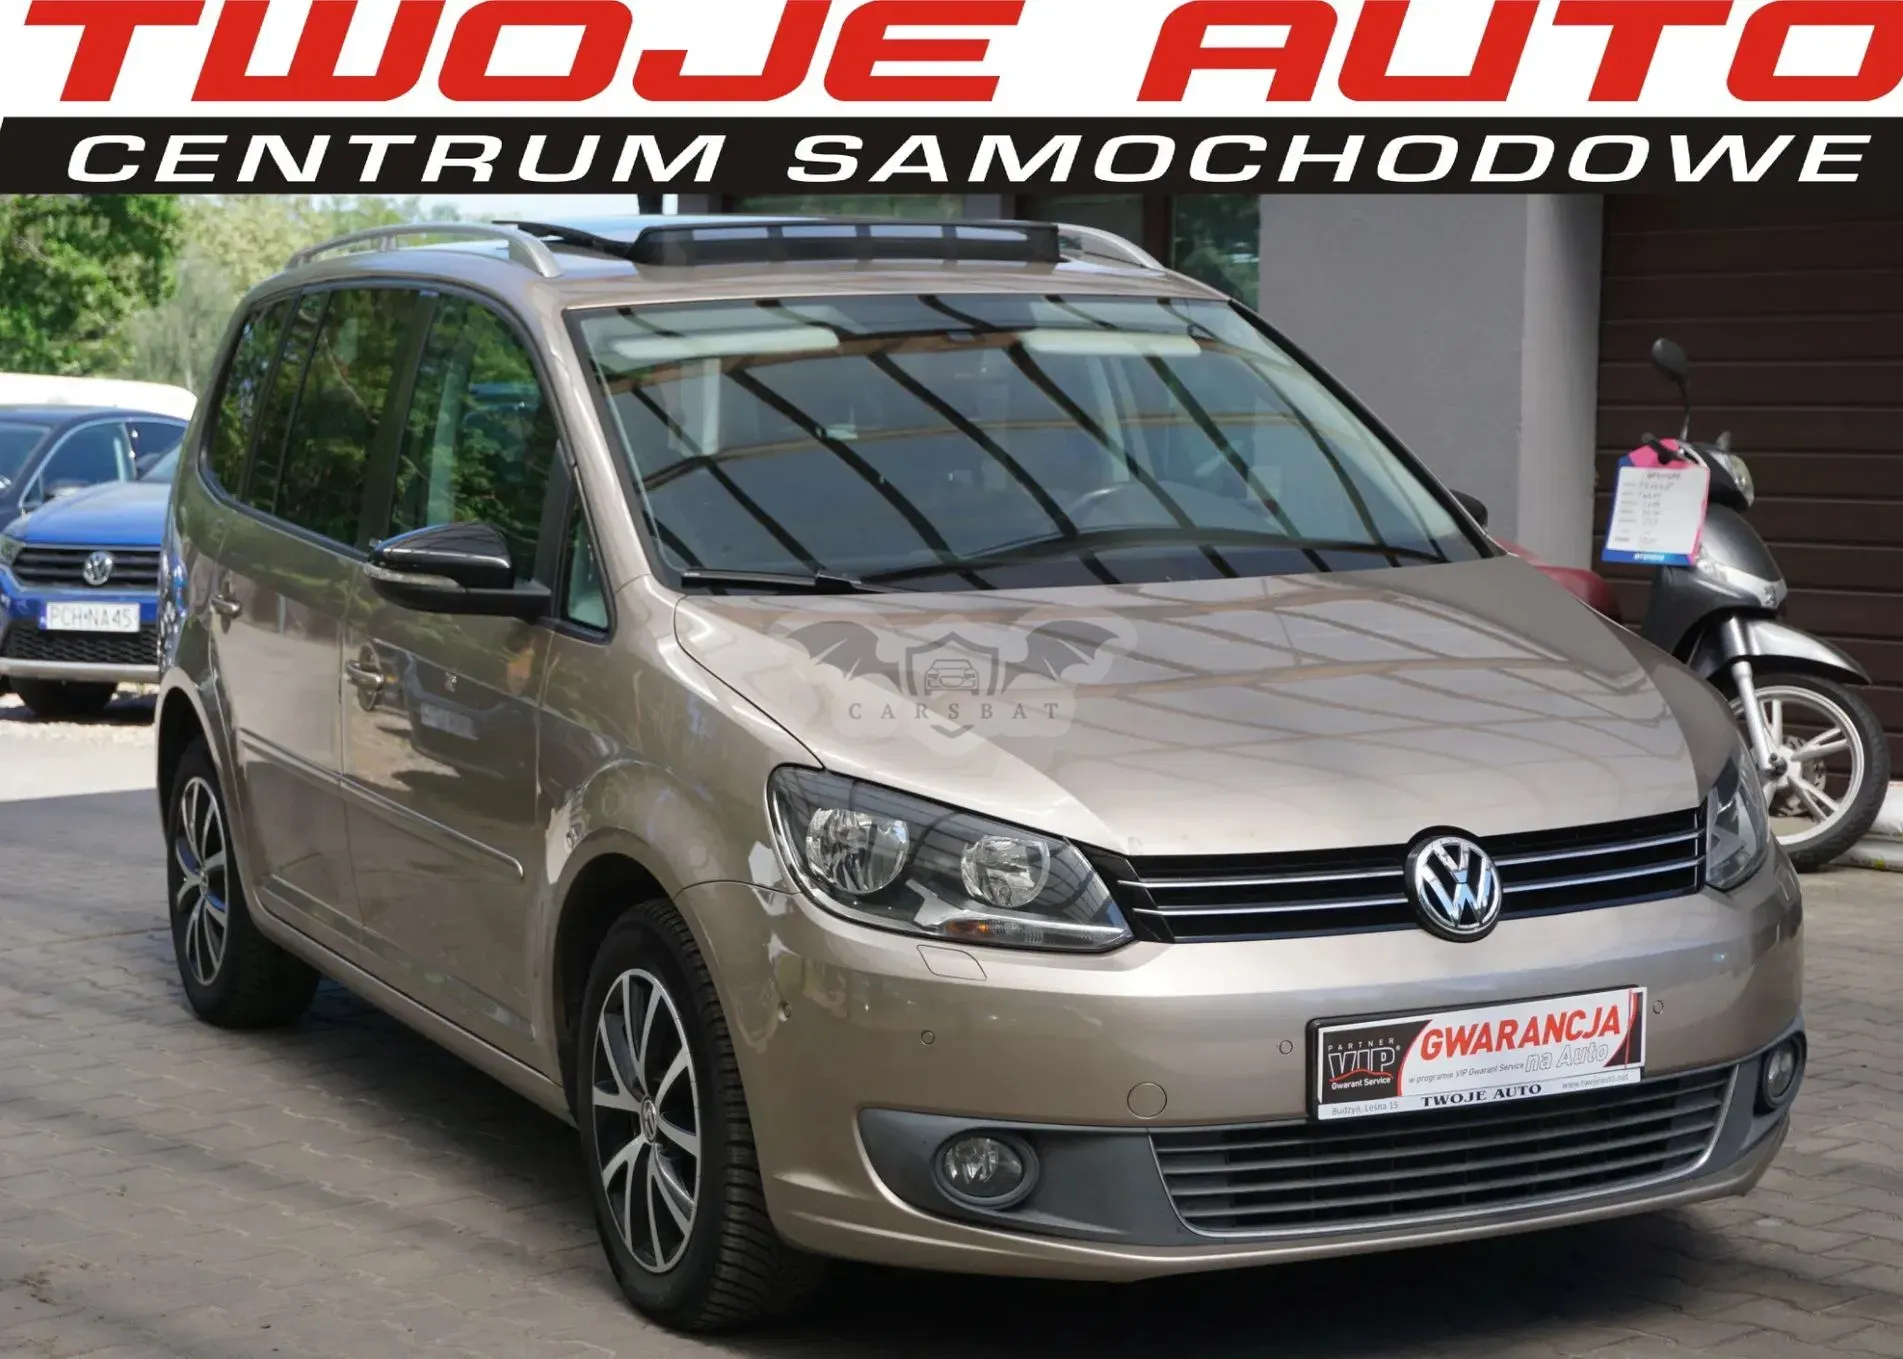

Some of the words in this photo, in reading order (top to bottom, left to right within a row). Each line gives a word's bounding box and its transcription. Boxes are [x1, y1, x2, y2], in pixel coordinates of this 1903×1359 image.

[1328, 1038, 1394, 1051] PARTNER
[1420, 1005, 1621, 1061] GWARANCJA
[1328, 1047, 1395, 1079] VIP
[1525, 1051, 1553, 1072] na
[1556, 1041, 1609, 1068] Auto
[1456, 1068, 1467, 1078] VIP
[1468, 1065, 1498, 1076] Gwarant
[1499, 1062, 1525, 1072] Service
[1331, 1079, 1362, 1090] Gwarant
[1363, 1076, 1392, 1087] Service
[1421, 1090, 1487, 1107] TWOJE
[1493, 1083, 1542, 1100] AUTO
